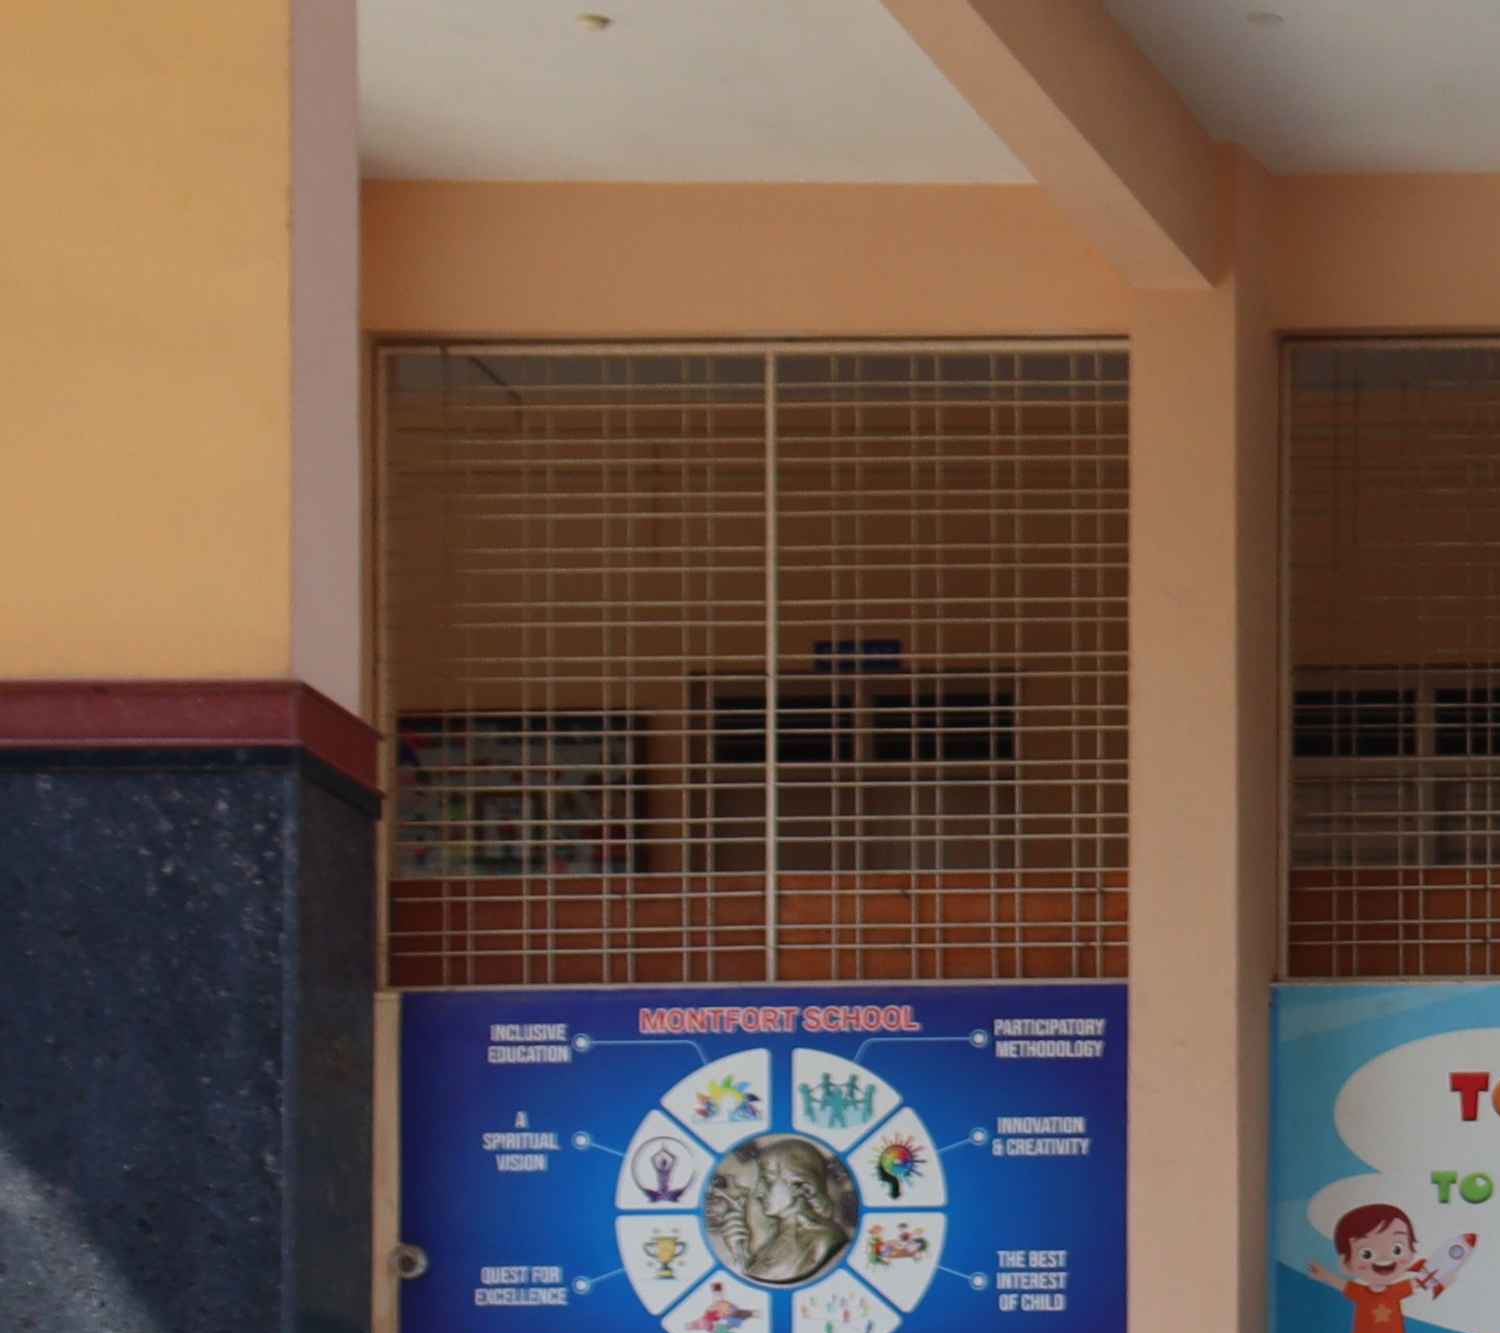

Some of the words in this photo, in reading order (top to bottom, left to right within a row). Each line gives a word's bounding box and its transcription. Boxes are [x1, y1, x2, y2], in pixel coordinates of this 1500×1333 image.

[640, 1009, 796, 1033] MONTFORT
[804, 1006, 920, 1031] SCHOOL
[994, 1019, 1104, 1037] PARTICIPATORY
[491, 1025, 566, 1043] INCLUSIVE
[488, 1045, 570, 1063] EDUCATION
[995, 1040, 1104, 1059] METHODOLOGY
[516, 1112, 527, 1128] A
[998, 1118, 1085, 1134] INNOVATION
[484, 1133, 559, 1150] SPIRITUAL
[993, 1139, 1004, 1156] &
[1009, 1138, 1090, 1156] CREATIVITY
[497, 1153, 546, 1171] VISION
[1430, 1172, 1493, 1202] TO
[998, 1251, 1024, 1268] THE
[1029, 1251, 1066, 1268] BEST
[482, 1267, 526, 1286] QUEST
[532, 1267, 561, 1285] FOR
[998, 1273, 1067, 1290] INTEREST
[476, 1289, 567, 1306] EXCELLENCE
[1000, 1295, 1017, 1311] OF
[1022, 1294, 1066, 1310] CHILD
